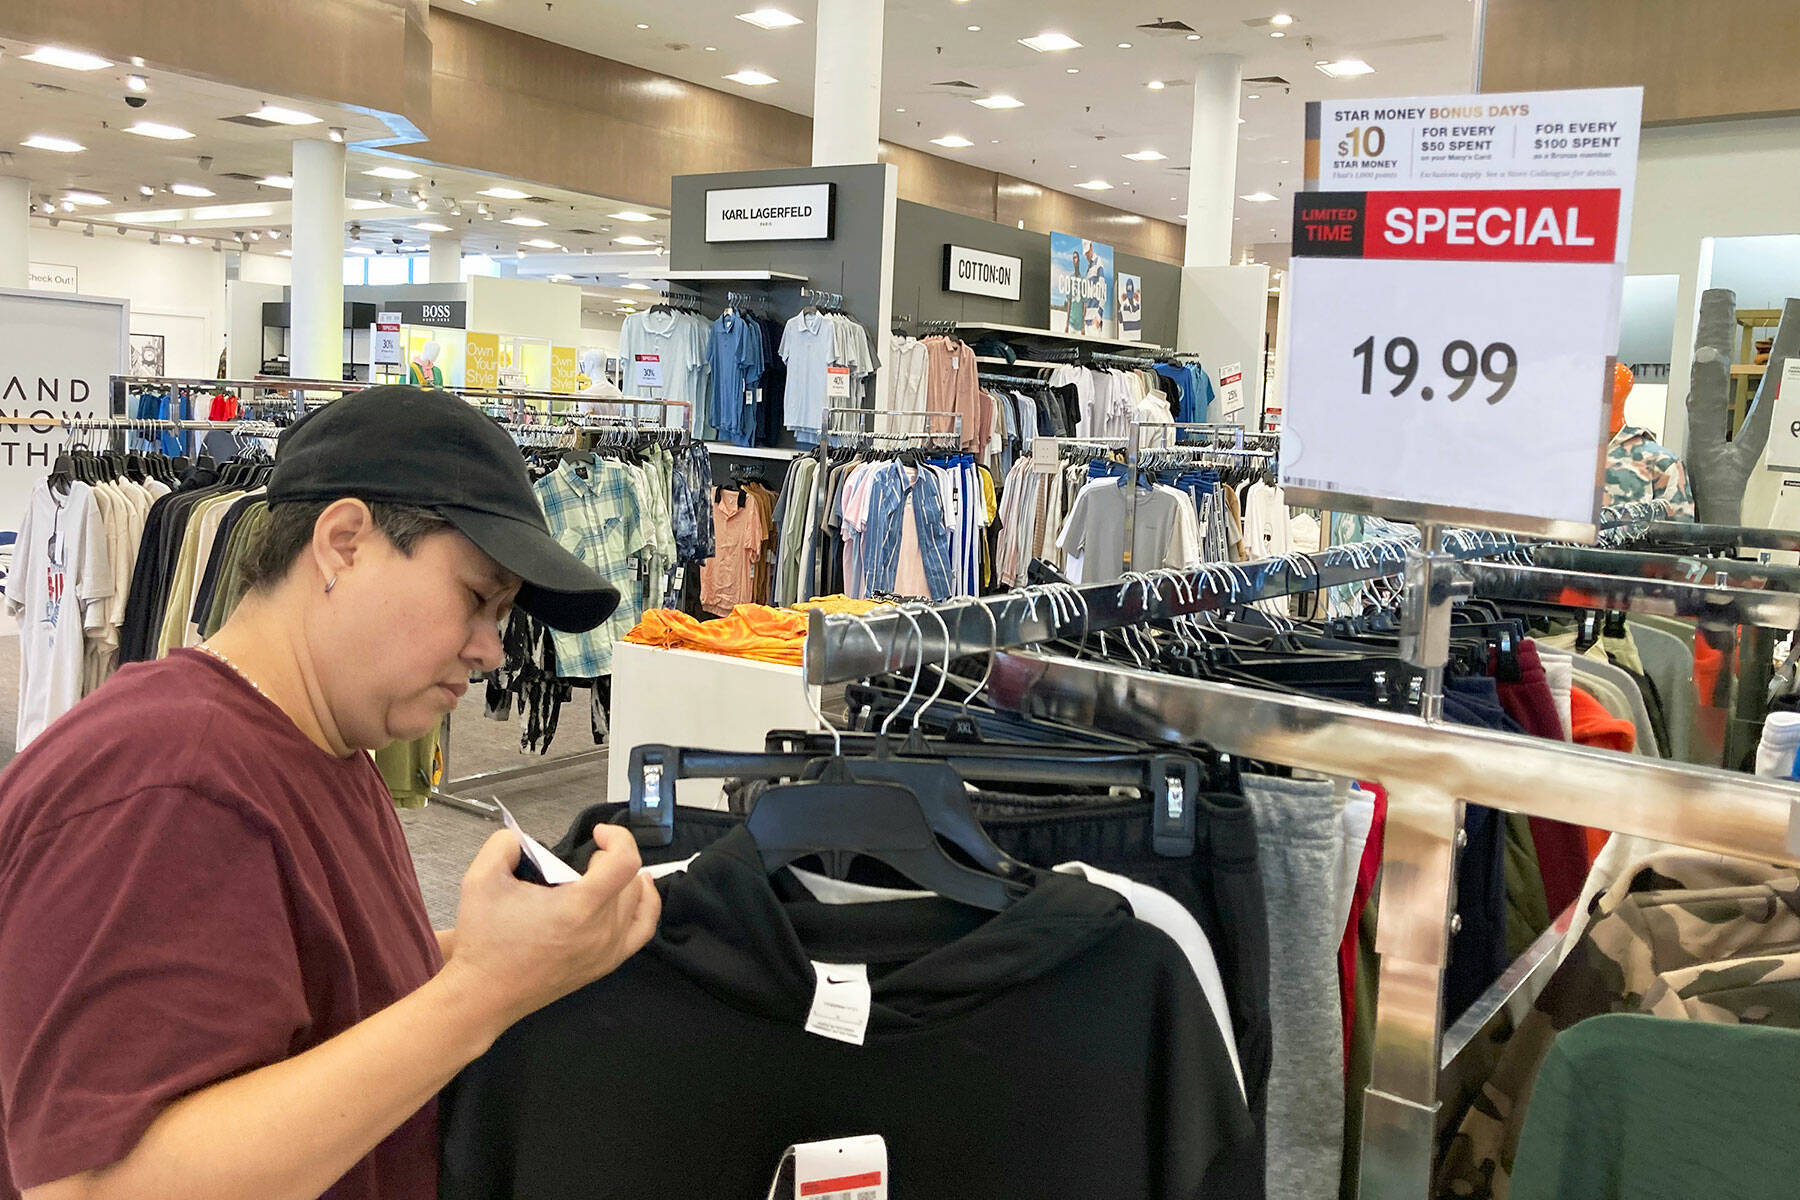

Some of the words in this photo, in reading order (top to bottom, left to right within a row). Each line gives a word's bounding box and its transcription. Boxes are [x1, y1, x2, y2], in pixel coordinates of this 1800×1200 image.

[1335, 110, 1369, 122] STAR
[1374, 108, 1426, 121] MONEY
[1430, 106, 1483, 119] BONUS
[1488, 104, 1530, 117] DAYS
[1422, 127, 1448, 138] FOR
[1452, 125, 1496, 137] EVERY
[1536, 124, 1564, 134] FOR
[1569, 121, 1617, 134] EVERY
[1338, 126, 1385, 158] $10
[1421, 141, 1445, 152] $50
[1449, 140, 1492, 152] SPENT
[1534, 138, 1568, 150] $100
[1572, 136, 1621, 149] SPENT
[1333, 160, 1358, 169] STAR
[1361, 160, 1399, 169] MONEY
[722, 209, 748, 221] KARL
[750, 206, 812, 219] LAGERFELD
[1301, 208, 1357, 221] LIMITED
[1384, 206, 1595, 246] SPECIAL
[1305, 224, 1353, 242] TIME
[29, 273, 53, 283] heck
[958, 259, 1011, 286] COTTON:ON
[422, 304, 451, 318] BOSS
[467, 342, 494, 357] Own
[473, 356, 499, 371] Your
[551, 354, 572, 367] Own
[466, 369, 495, 386] Style
[556, 366, 577, 378] Your
[1353, 335, 1518, 405] 19.99
[3, 375, 90, 403] AND
[551, 377, 572, 391] Style
